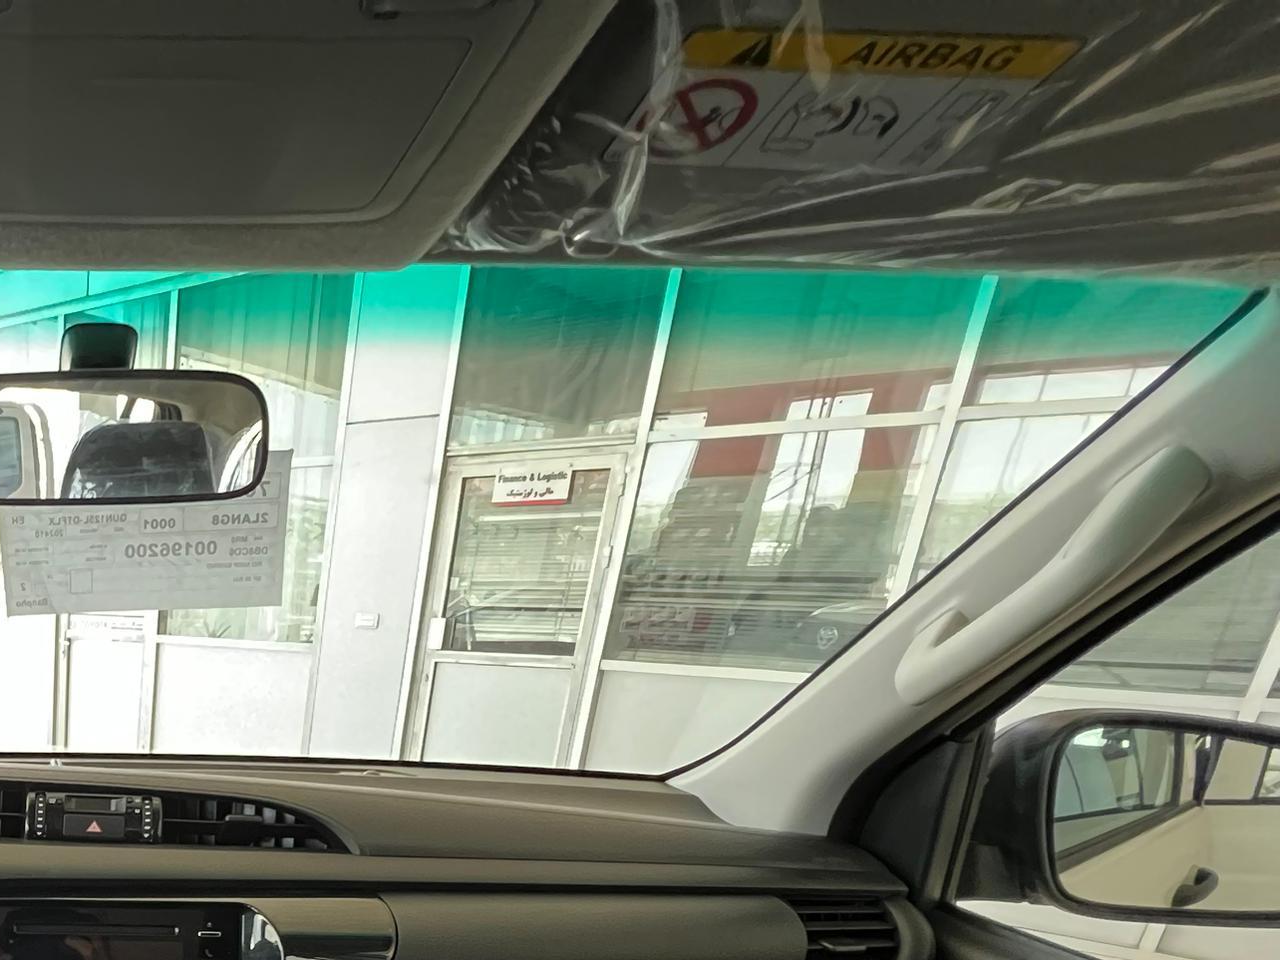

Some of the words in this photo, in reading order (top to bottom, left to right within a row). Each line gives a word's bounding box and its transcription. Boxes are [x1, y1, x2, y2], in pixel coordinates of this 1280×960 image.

[839, 40, 1024, 73] AIRBAG
[529, 472, 535, 482] &
[537, 471, 568, 483] Logistic
